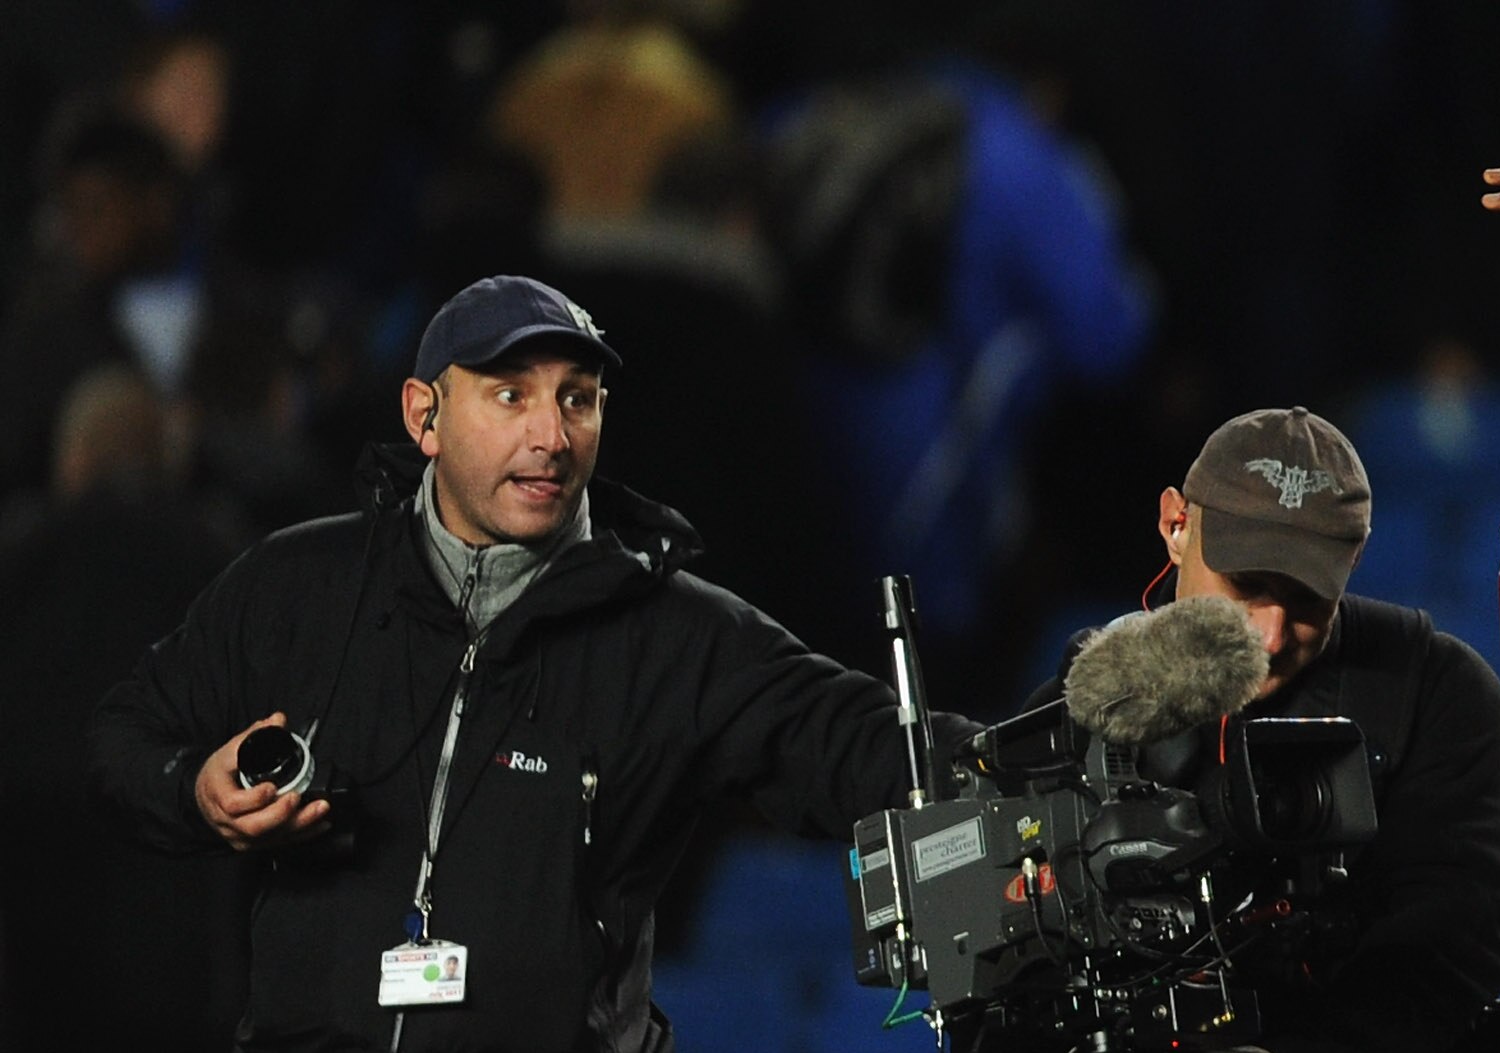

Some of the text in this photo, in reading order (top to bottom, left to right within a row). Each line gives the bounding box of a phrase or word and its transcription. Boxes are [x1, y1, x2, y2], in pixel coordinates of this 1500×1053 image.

[508, 750, 548, 773] Rab
[940, 838, 978, 858] charter
[1109, 841, 1148, 856] Canon
